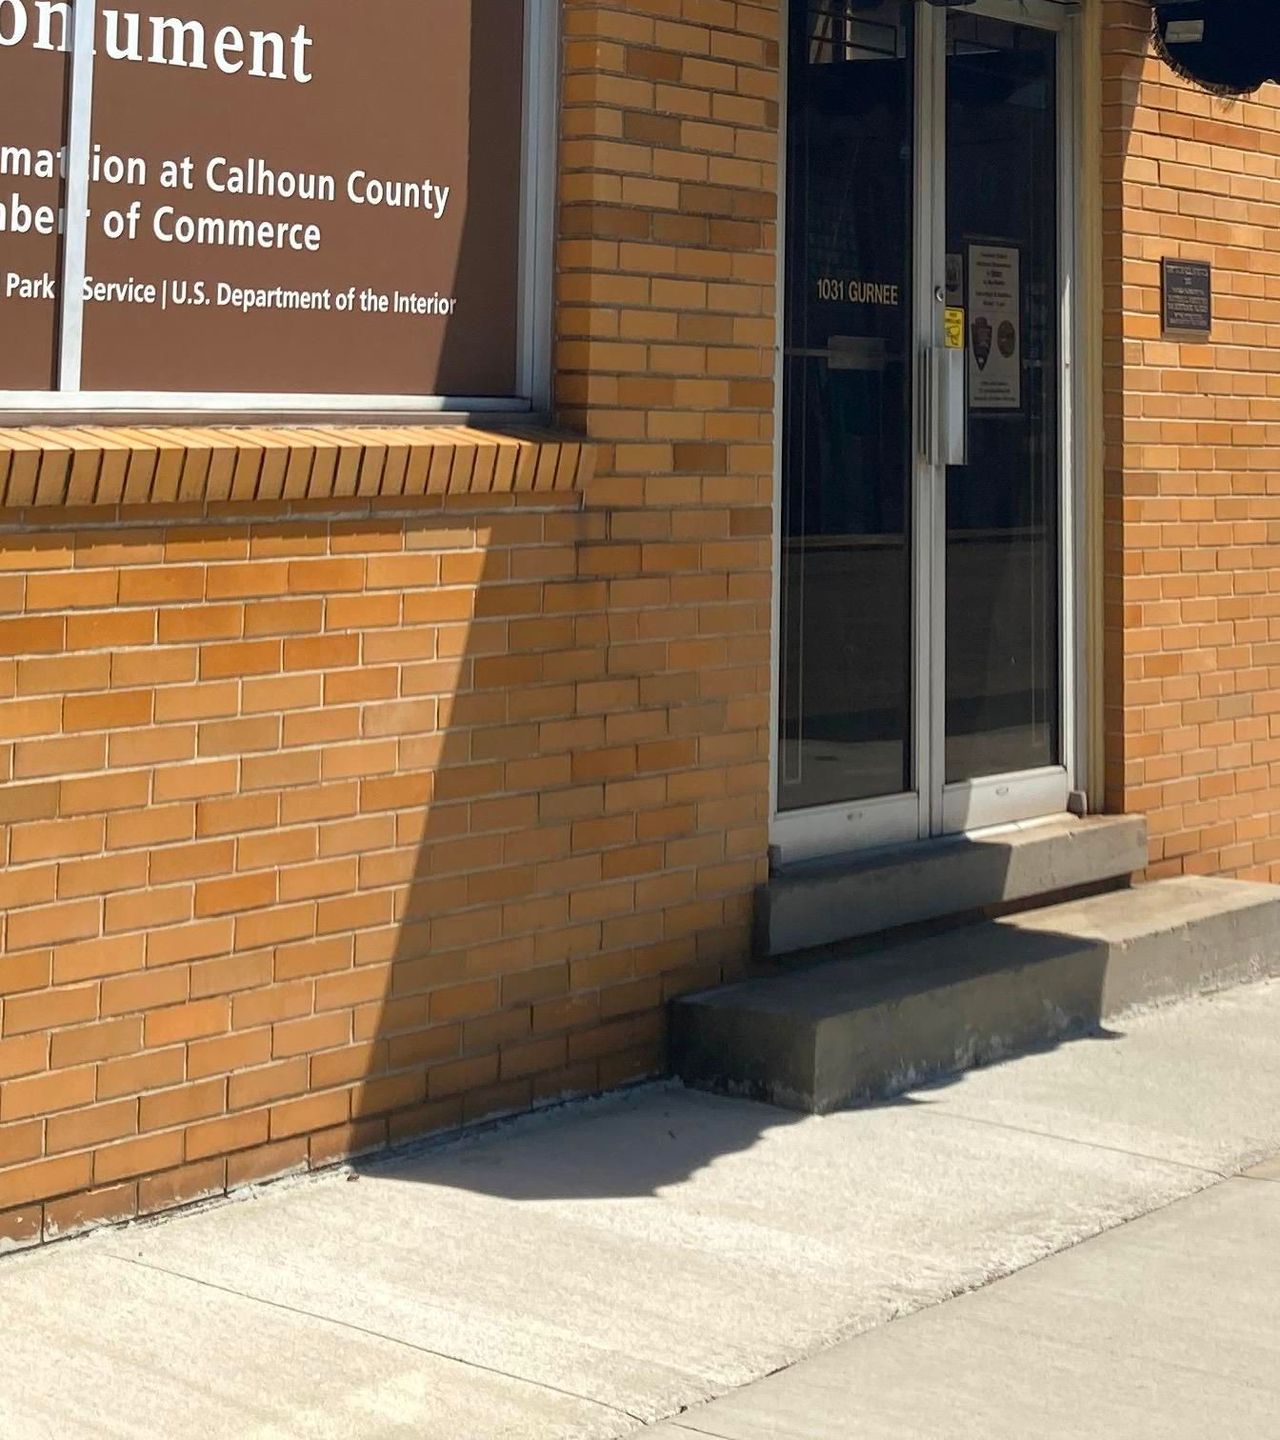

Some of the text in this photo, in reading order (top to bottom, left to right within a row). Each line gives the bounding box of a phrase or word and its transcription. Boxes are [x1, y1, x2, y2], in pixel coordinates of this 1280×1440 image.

[159, 155, 194, 190] at
[206, 155, 336, 201] Calhoun
[347, 170, 450, 219] County
[103, 200, 141, 240] of
[153, 205, 321, 251] Commerce
[6, 272, 56, 299] Park
[81, 275, 156, 303] Service
[172, 280, 210, 307] U.S.
[217, 282, 331, 312] Department
[335, 287, 357, 311] of
[359, 291, 389, 313] the
[393, 291, 457, 316] Interior
[817, 278, 898, 305] 1031 GURNEE
